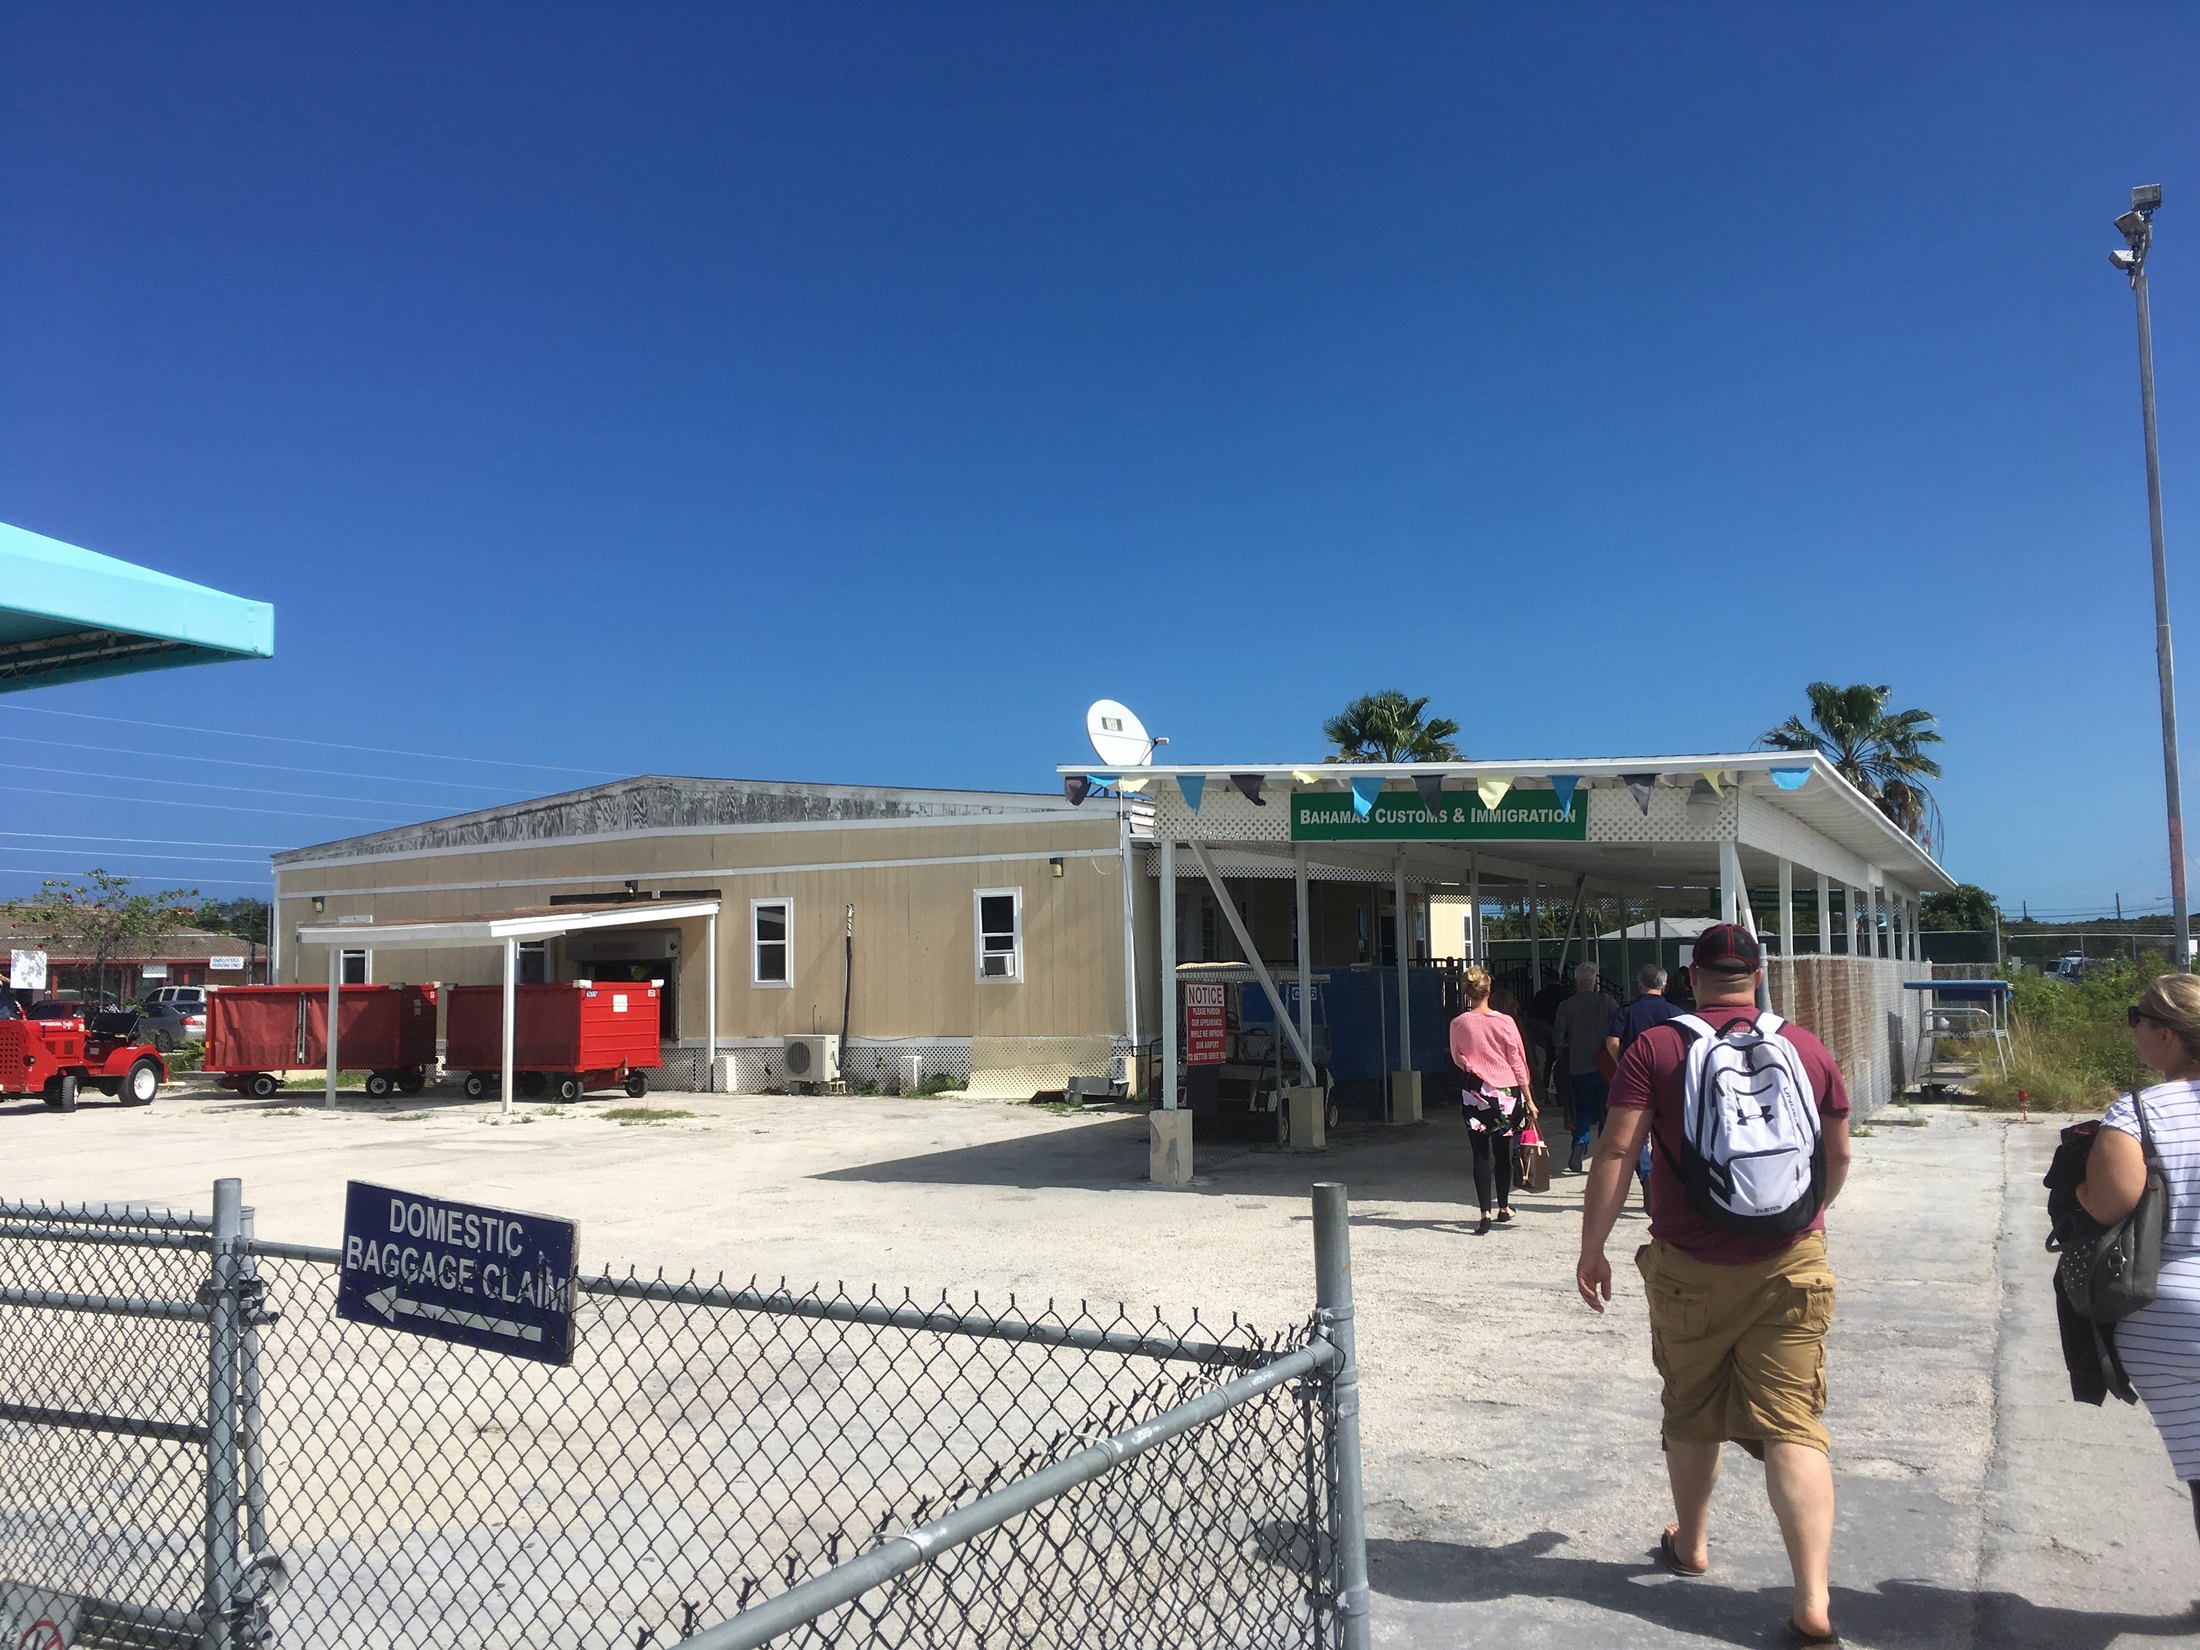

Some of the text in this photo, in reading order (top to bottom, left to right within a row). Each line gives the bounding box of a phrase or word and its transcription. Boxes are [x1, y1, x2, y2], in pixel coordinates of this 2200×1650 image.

[1300, 808, 1576, 824] BAHAMAS CUSTOMS & IMMIGRATION
[1188, 987, 1223, 1004] NOTICE
[1192, 1007, 1206, 1015] PLEASE
[1191, 1018, 1200, 1027] OUR
[1190, 1029, 1224, 1038] WHILE WE IMPROVE
[1195, 1040, 1220, 1049] OUR AIRPORT
[1193, 1052, 1208, 1061] BETTER
[390, 1198, 524, 1257] DOMESTIC
[345, 1235, 567, 1314] BAGGAGE CLAIM
